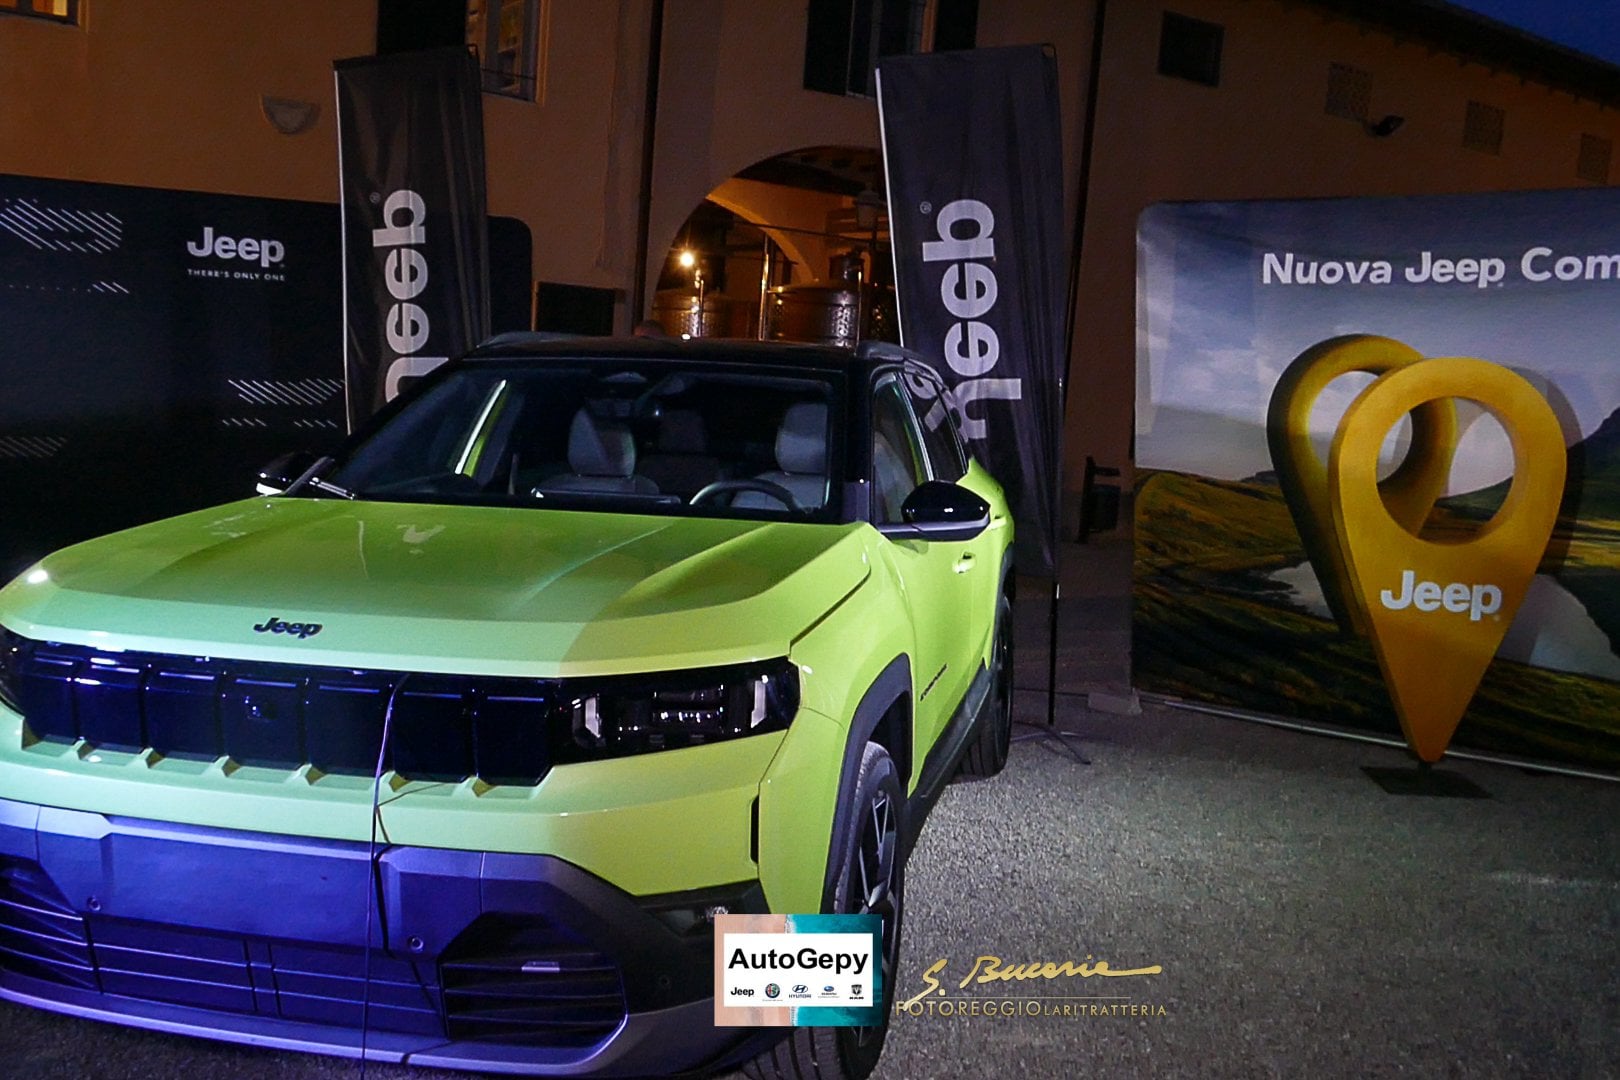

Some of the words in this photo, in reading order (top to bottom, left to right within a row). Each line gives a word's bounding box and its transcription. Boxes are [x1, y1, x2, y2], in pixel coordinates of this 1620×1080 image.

[187, 226, 285, 268] Jeep
[1262, 252, 1392, 285] Nuova
[1405, 251, 1505, 288] Jeep
[1521, 246, 1620, 282] Com
[187, 268, 230, 279] THERE'S
[233, 271, 260, 280] ONLY
[263, 273, 286, 281] ONE
[922, 199, 1022, 439] Jeep
[1380, 570, 1501, 621] Jeep
[253, 617, 323, 639] Jeep
